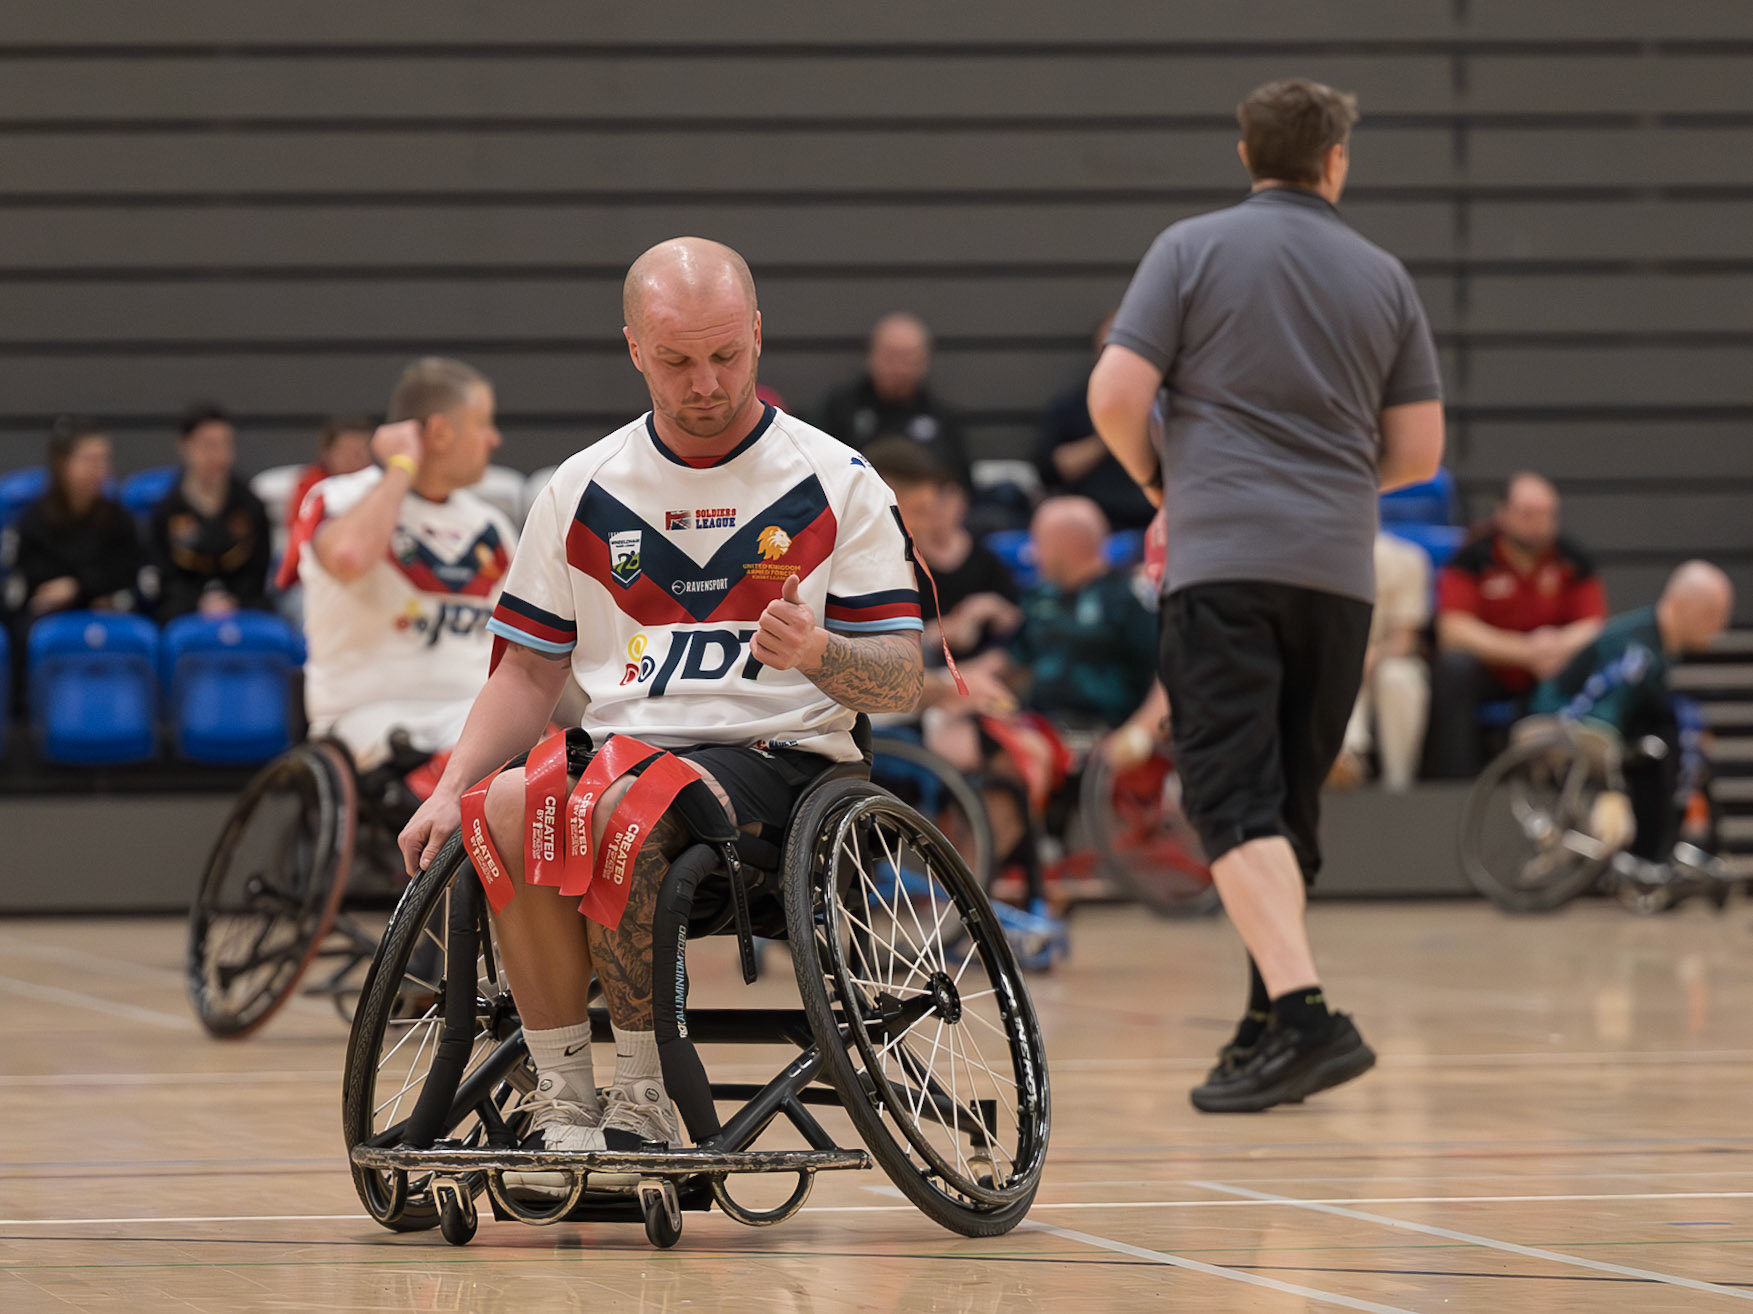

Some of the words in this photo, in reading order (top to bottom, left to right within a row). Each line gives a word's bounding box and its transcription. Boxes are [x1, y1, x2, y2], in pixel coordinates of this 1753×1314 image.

[695, 508, 737, 517] SOLDIERS
[695, 517, 736, 529] LEAGUE
[768, 563, 801, 571] KINGDOM
[686, 578, 729, 593] RAVENSPORT
[536, 809, 544, 821] BY
[544, 796, 556, 861] CREATED
[578, 792, 593, 856] CREATED
[614, 832, 624, 845] BY
[473, 818, 500, 878] CREATED
[614, 824, 639, 884] CREATED
[675, 955, 685, 1021] ALUMINIUM
